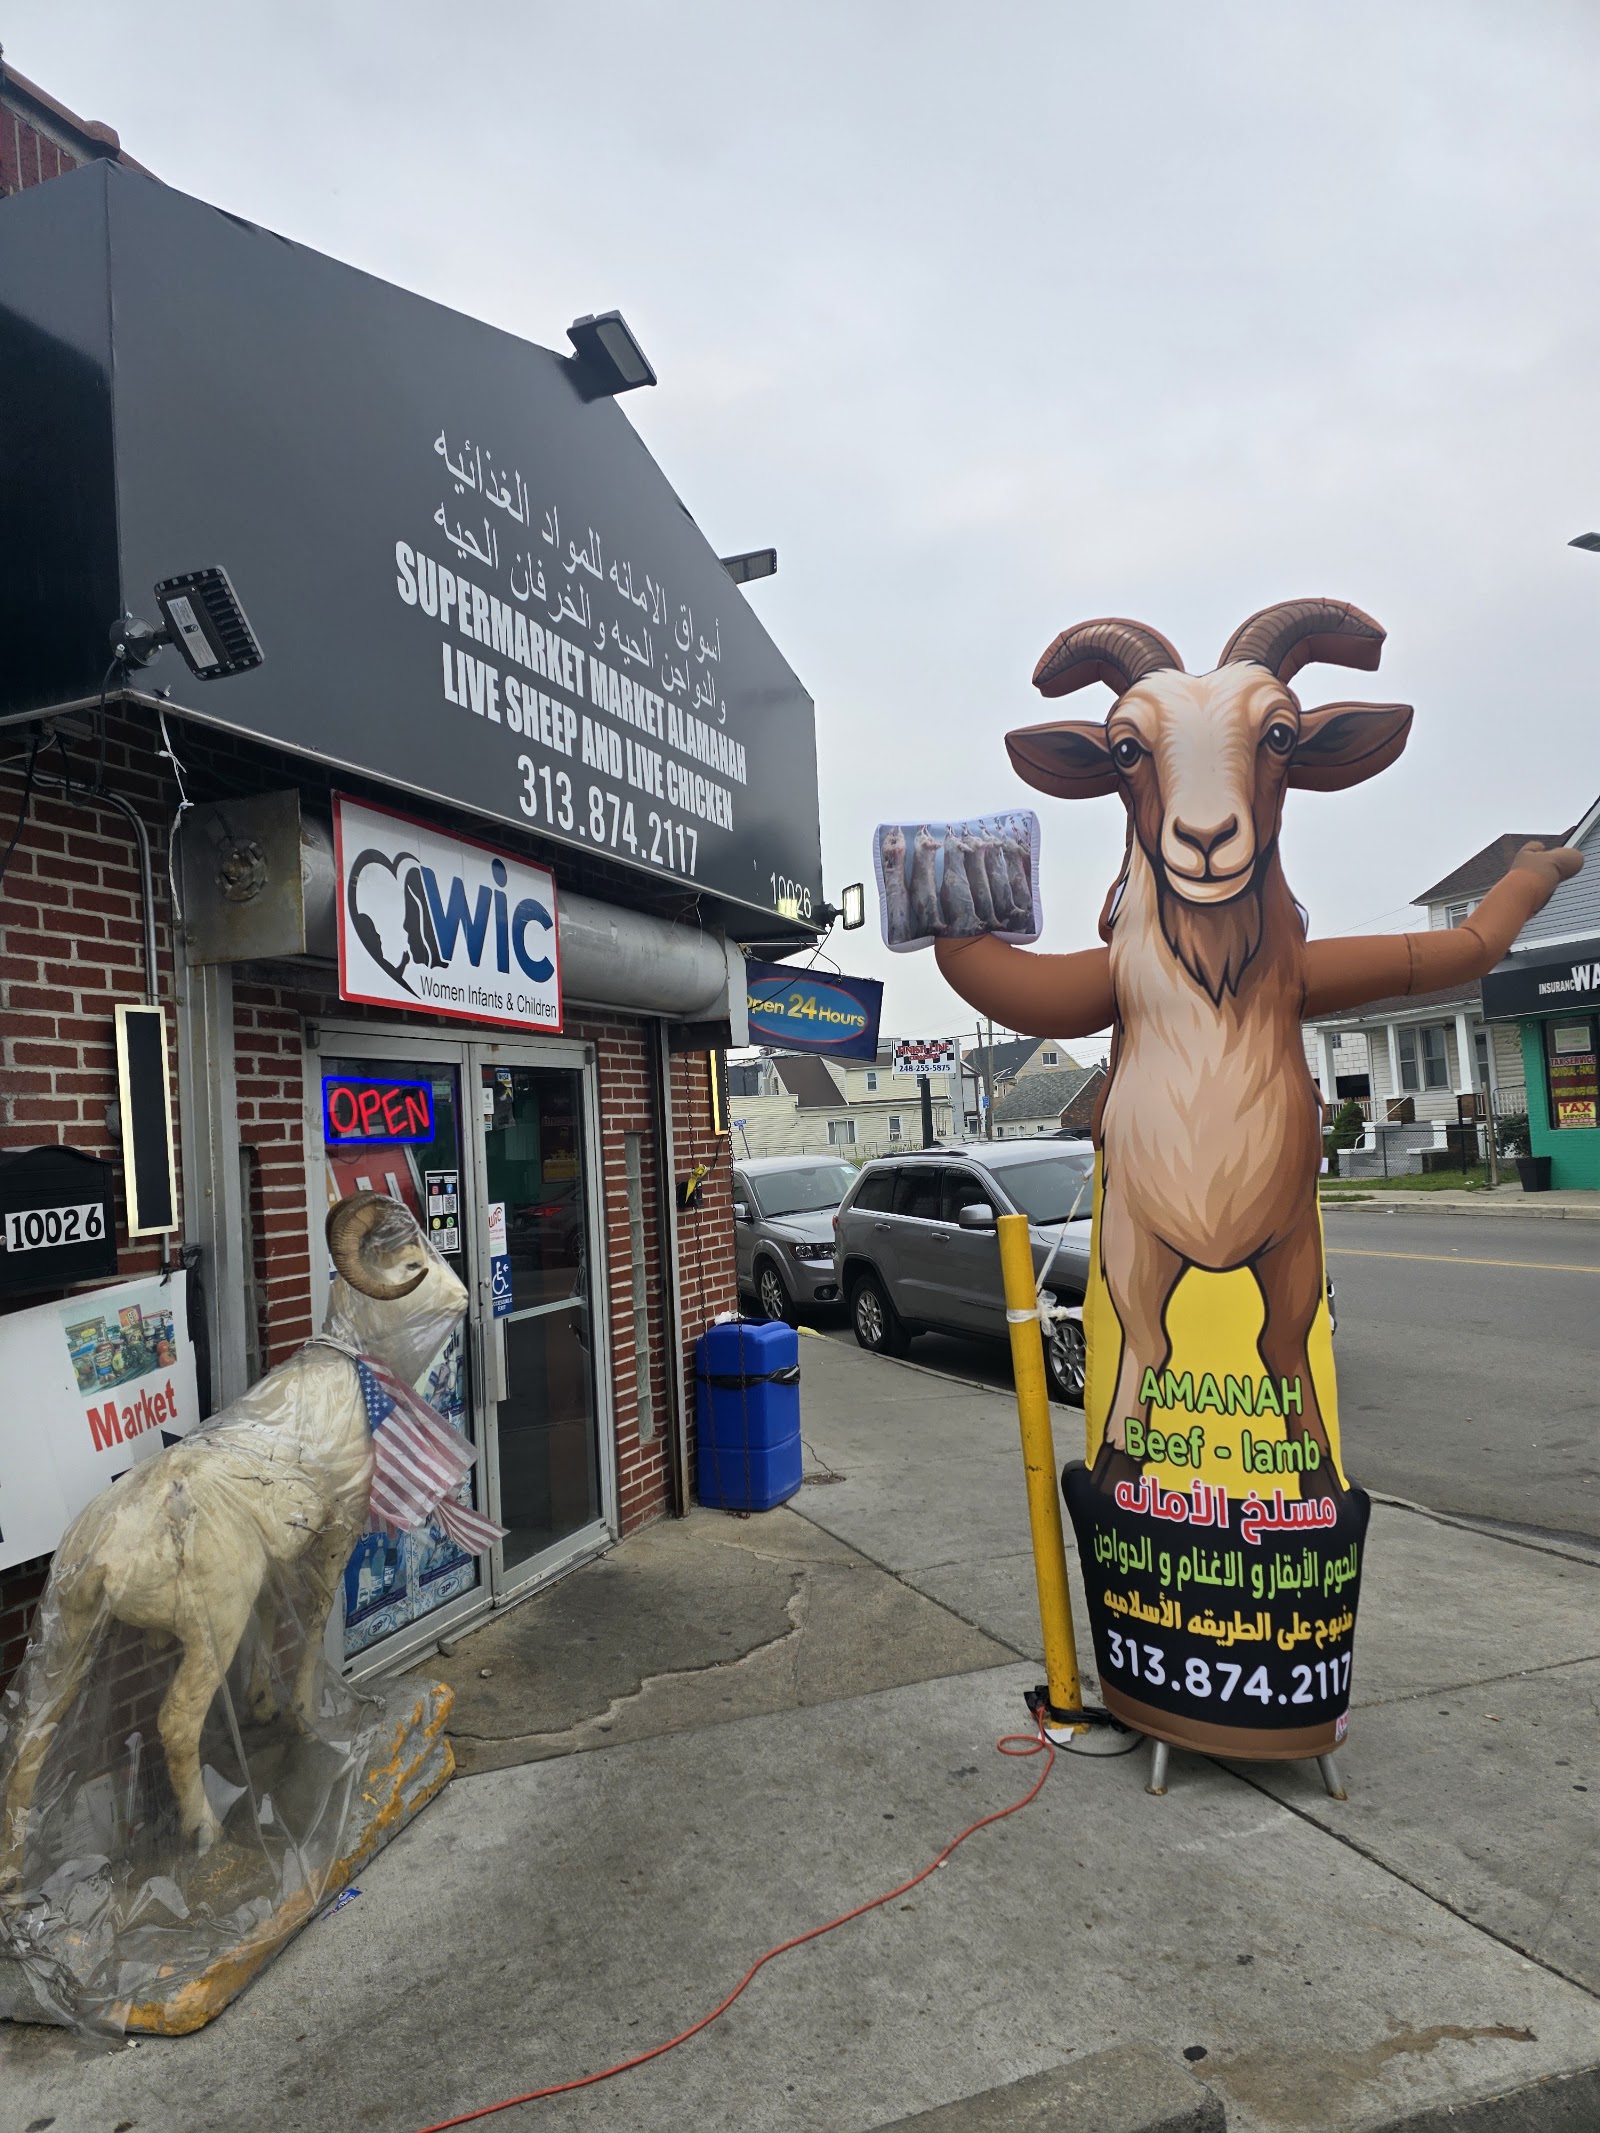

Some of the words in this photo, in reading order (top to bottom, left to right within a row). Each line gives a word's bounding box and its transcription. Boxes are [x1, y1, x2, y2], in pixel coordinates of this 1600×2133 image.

[395, 540, 585, 699] SUPERMARKET
[589, 654, 665, 741] MARKET
[667, 701, 748, 786] ALAMANAH
[442, 641, 501, 724] LIVE
[504, 675, 578, 758] SHEEP
[582, 714, 623, 780] AND
[625, 737, 665, 800] LIVE
[666, 759, 734, 832] CHICKEN
[517, 754, 698, 877] 313.874.2117
[770, 871, 812, 919] 10026
[419, 974, 465, 1003] Women
[468, 984, 503, 1010] Infants
[506, 992, 514, 1011] &
[517, 994, 557, 1019] Children
[787, 993, 818, 1020] 24
[818, 1006, 866, 1027] Hours
[899, 1064, 951, 1072] 248-255-5875
[929, 1042, 950, 1053] LINE
[1564, 1054, 1597, 1066] SERVICE
[329, 1086, 430, 1135] OPEN
[1560, 1102, 1592, 1114] TAX
[12, 1205, 102, 1250] 10026
[86, 1378, 178, 1453] Market
[1138, 1366, 1304, 1418] AMANAH
[1124, 1416, 1205, 1470] Beef
[1240, 1428, 1322, 1475] lamb
[1114, 1475, 1231, 1529] الأمانه
[1240, 1487, 1338, 1546] مسلخ
[1093, 1522, 1153, 1575] الدواجن
[1158, 1551, 1172, 1587] و
[1176, 1546, 1245, 1592] الاغنام
[1250, 1563, 1264, 1600] و
[1267, 1546, 1319, 1600] الأبقار
[1187, 1608, 1272, 1648] الطريقه
[1276, 1611, 1313, 1651] على
[1107, 1628, 1351, 1705] 313.874.2117
